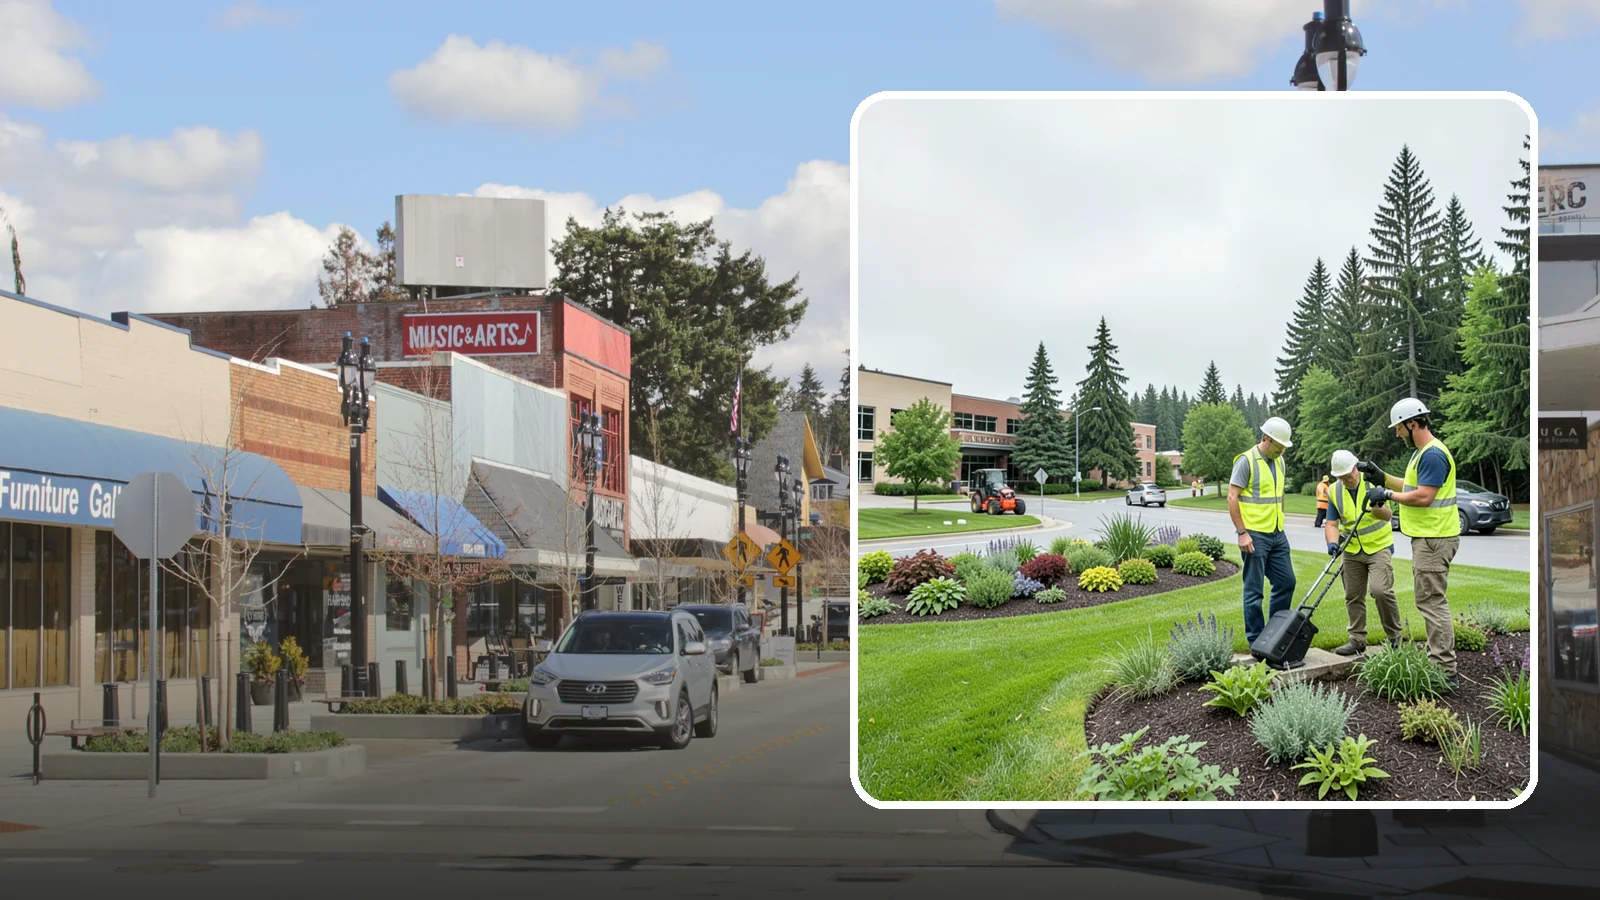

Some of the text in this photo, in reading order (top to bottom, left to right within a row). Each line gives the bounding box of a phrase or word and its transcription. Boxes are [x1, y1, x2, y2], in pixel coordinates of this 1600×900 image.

[408, 322, 520, 349] MUSIC&ARTS
[0, 471, 79, 515] Furniture
[453, 563, 480, 574] SUSHI
